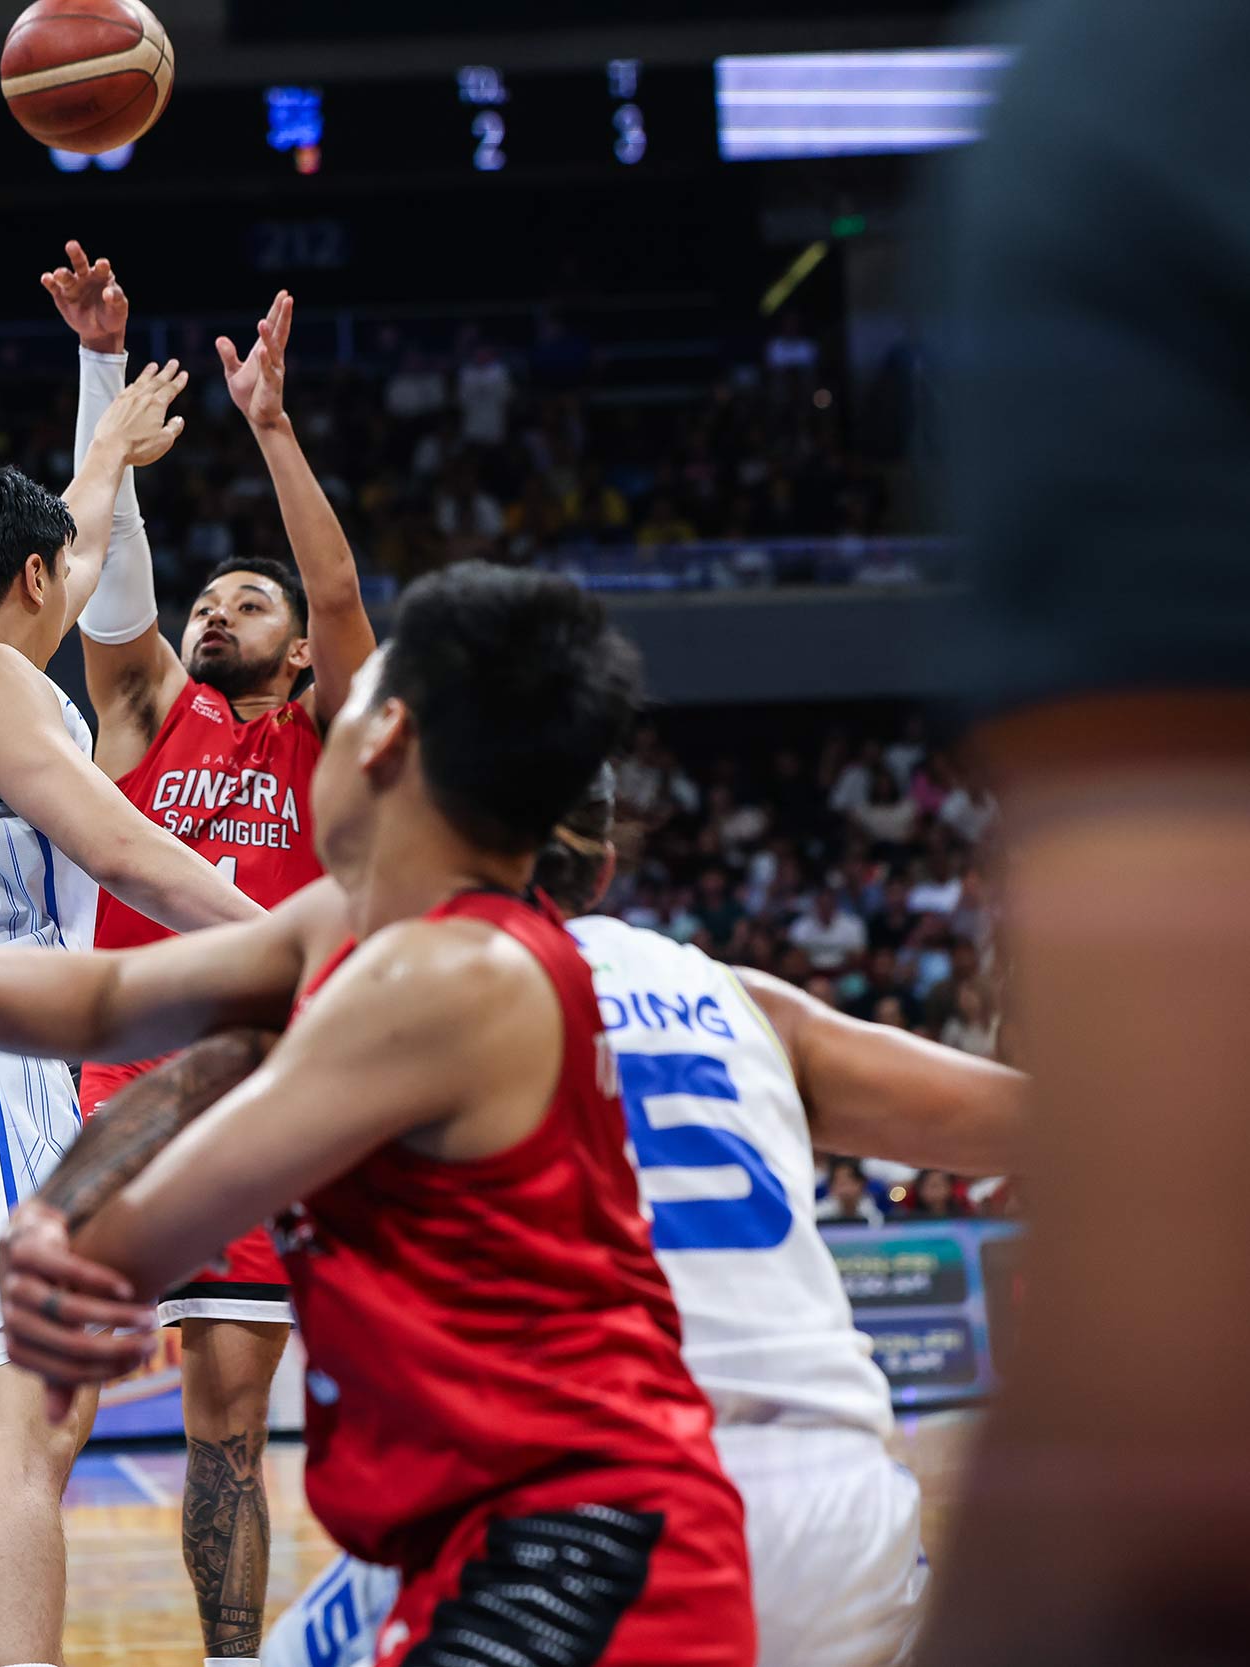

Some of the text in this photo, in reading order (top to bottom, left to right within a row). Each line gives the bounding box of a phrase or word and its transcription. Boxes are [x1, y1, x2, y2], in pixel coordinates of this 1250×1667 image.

[471, 109, 507, 171] 2
[208, 817, 292, 849] MIGUEL
[617, 1052, 794, 1251] 5
